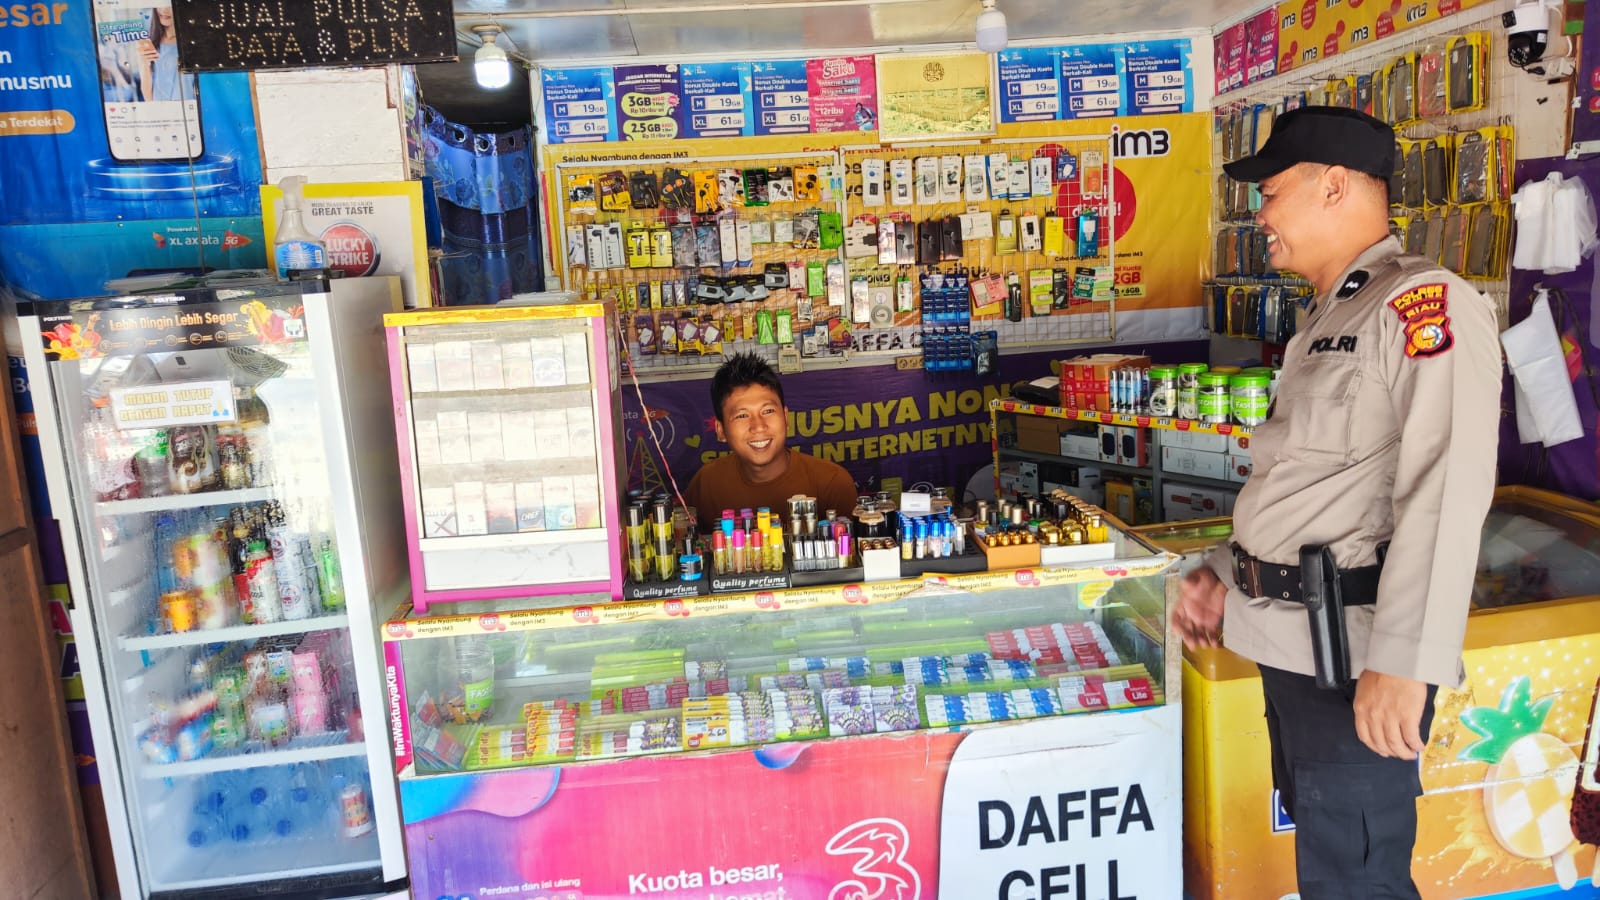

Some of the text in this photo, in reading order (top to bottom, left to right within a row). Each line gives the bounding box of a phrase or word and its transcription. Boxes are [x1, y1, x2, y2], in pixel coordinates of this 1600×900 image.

[206, 0, 424, 29] JUAL PULSA
[1282, 12, 1296, 29] im3
[1407, 3, 1427, 22] im3
[101, 22, 144, 31] Streaming
[1351, 26, 1368, 43] im3
[112, 29, 150, 43] Time
[225, 26, 410, 59] DATA & PLN
[1303, 47, 1318, 61] im3
[628, 96, 651, 106] 3GB
[9, 116, 64, 128] Terdekat
[1112, 125, 1169, 157] im3
[562, 155, 589, 163] Selalu
[312, 205, 375, 217] GREAT TASTE
[169, 235, 239, 246] XL axata 5G
[328, 237, 367, 251] LUCKY
[327, 251, 370, 266] STRIKE
[1405, 302, 1440, 319] RIAU
[109, 311, 239, 331] Lebih Dingin Lebih Segar
[1307, 335, 1359, 355] POLRI
[173, 387, 213, 402] TUTUP
[713, 575, 787, 589] Quality perfume
[633, 585, 698, 598] Quality perfume
[1131, 691, 1149, 700] Lite
[387, 665, 406, 758] #IniWaktunyaKita
[977, 783, 1155, 850] DAFFA
[479, 877, 581, 897] Perdana dan isi ulang
[628, 871, 703, 895] Kuota
[708, 863, 784, 886] besar,
[998, 859, 1138, 900] CELL
